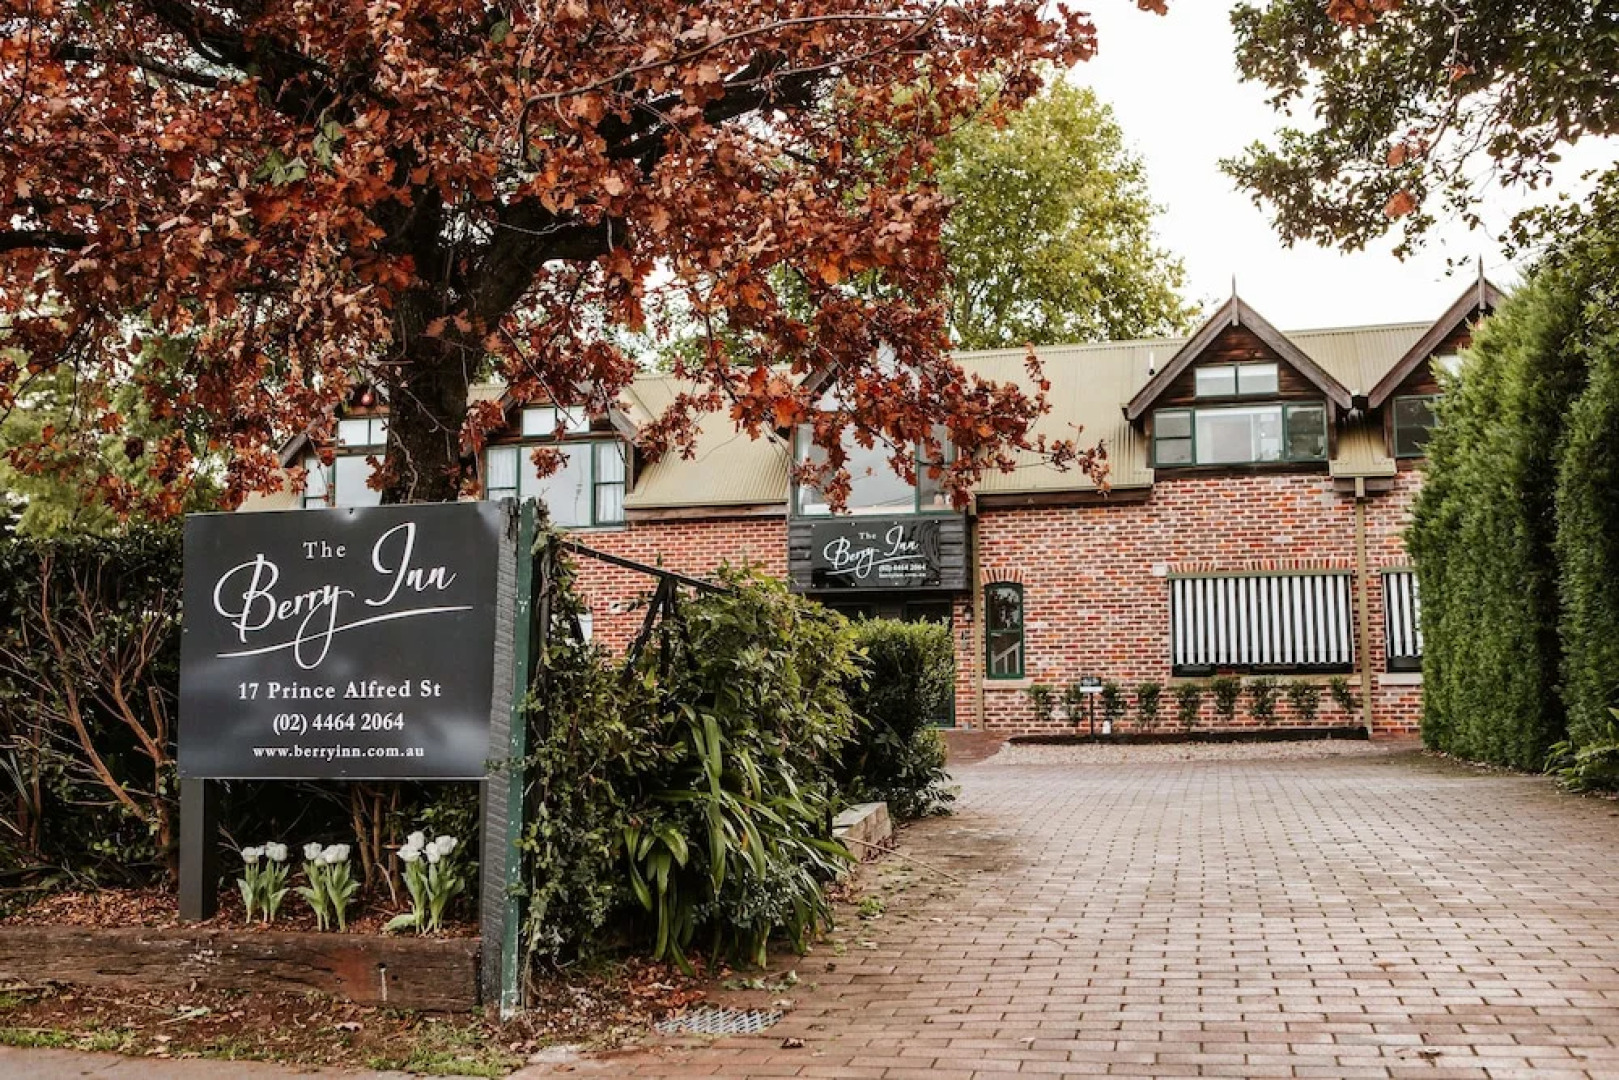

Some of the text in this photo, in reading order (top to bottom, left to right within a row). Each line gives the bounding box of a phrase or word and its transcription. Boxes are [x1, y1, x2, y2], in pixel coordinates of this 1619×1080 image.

[857, 532, 877, 540] The
[303, 541, 347, 559] The
[823, 525, 920, 579] Berry Inn
[213, 522, 458, 669] Berry Inn
[238, 679, 442, 700] 17 Prince Alfred St
[272, 712, 405, 736] (02) 4464 2064
[252, 744, 425, 762] www.berryinn.com.au
